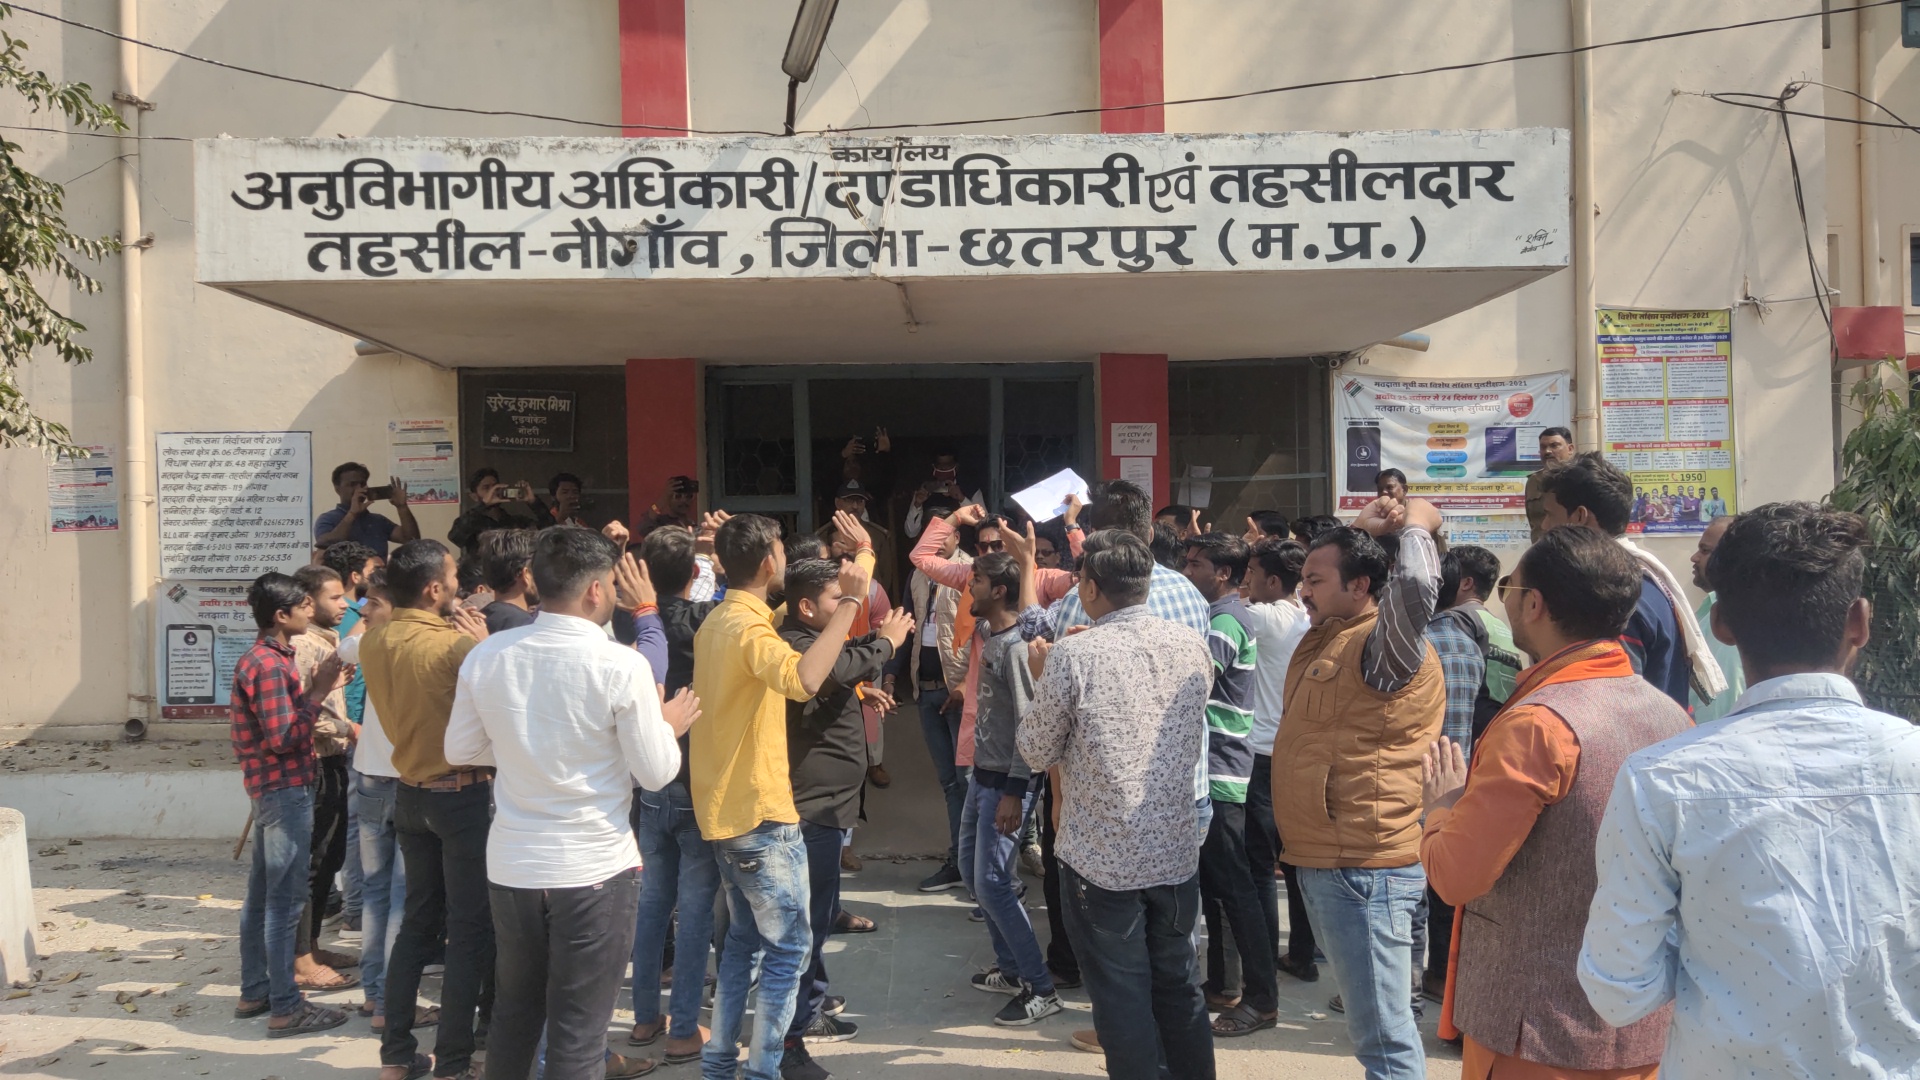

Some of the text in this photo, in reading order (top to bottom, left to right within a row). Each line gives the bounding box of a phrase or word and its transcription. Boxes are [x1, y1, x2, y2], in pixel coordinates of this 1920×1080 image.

[232, 158, 555, 221] अनुविभागीय
[1145, 152, 1203, 213] एवं
[1208, 150, 1514, 210] तहसीलदार
[487, 393, 571, 412] सुरेन्द्र कुमार मिश्रा
[1409, 403, 1421, 414] हेतु
[248, 460, 290, 470] महाराजपुर
[1680, 473, 1702, 481] 1950
[198, 610, 246, 621] मतदाता हेतु
